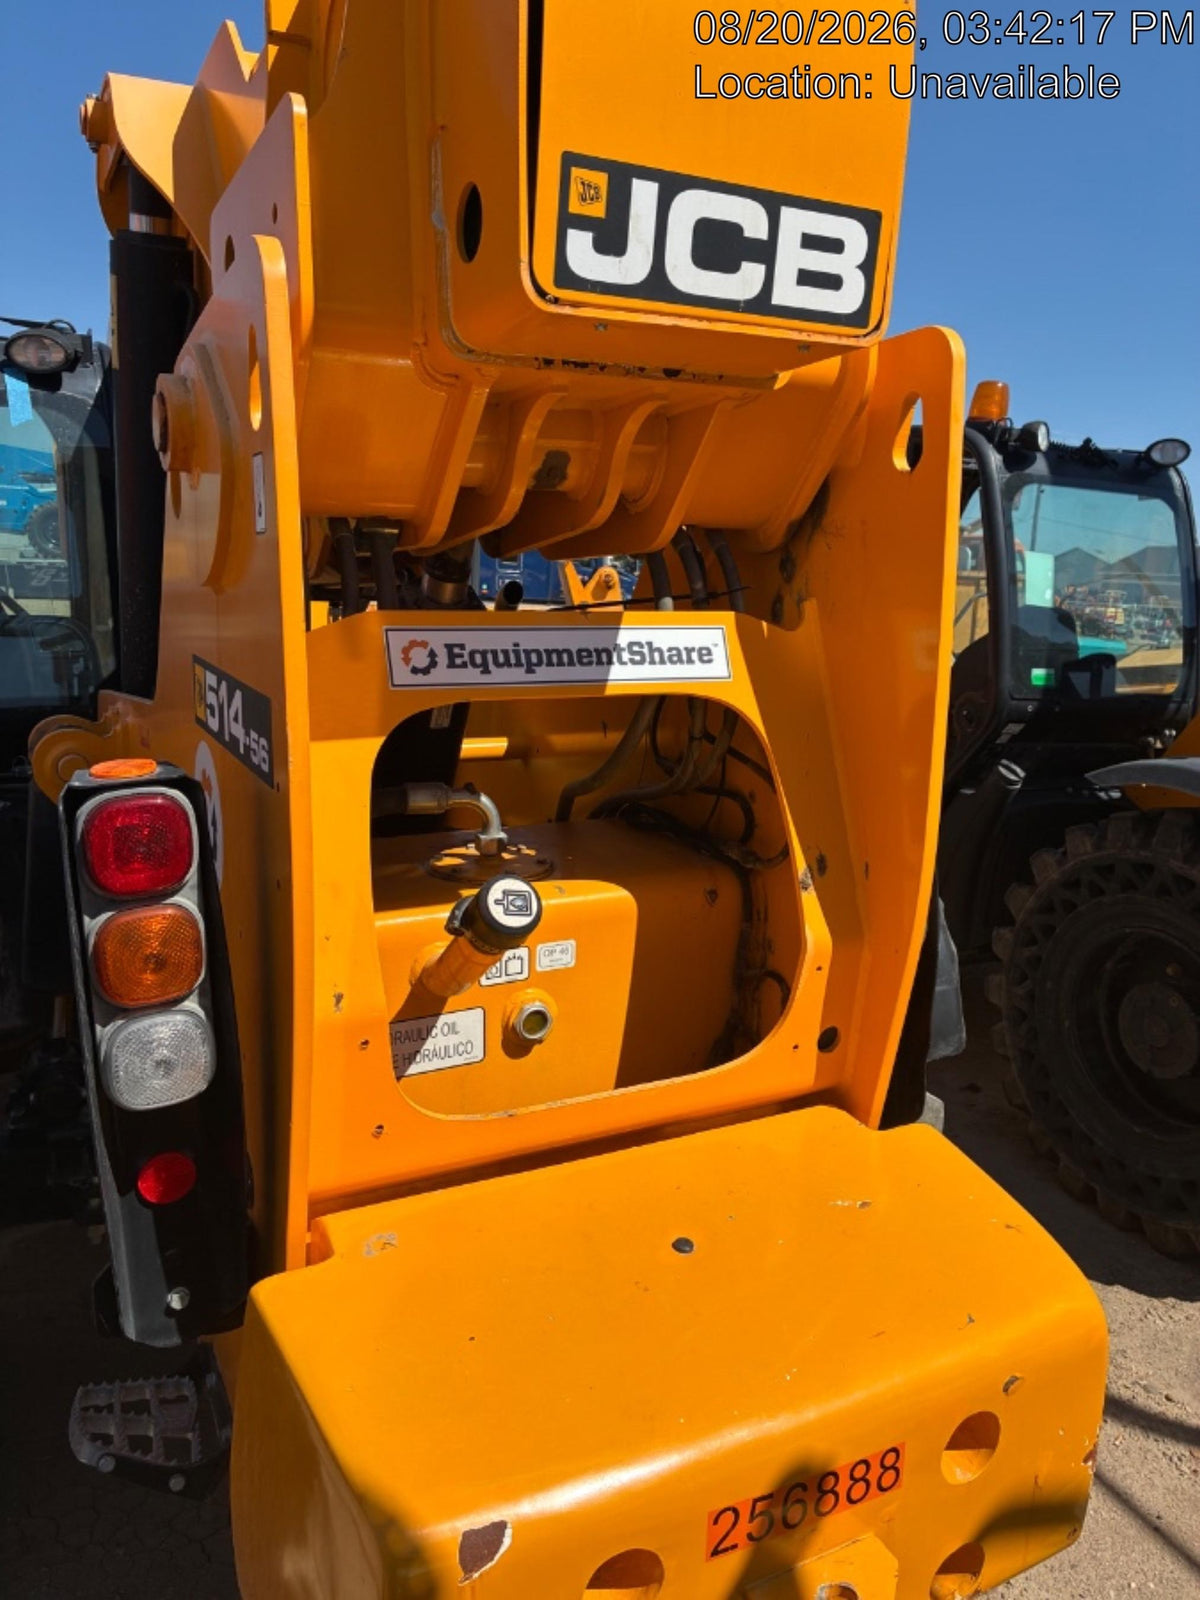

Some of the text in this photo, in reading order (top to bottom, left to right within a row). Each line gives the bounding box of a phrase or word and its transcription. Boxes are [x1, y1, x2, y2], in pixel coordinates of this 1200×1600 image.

[579, 180, 602, 204] JCB
[565, 177, 870, 315] JCB
[444, 641, 714, 675] EquipmentShare
[391, 1021, 461, 1046] RAULIC OIL
[402, 1040, 474, 1068] HIDRÁULICO
[709, 1446, 902, 1558] 256888
